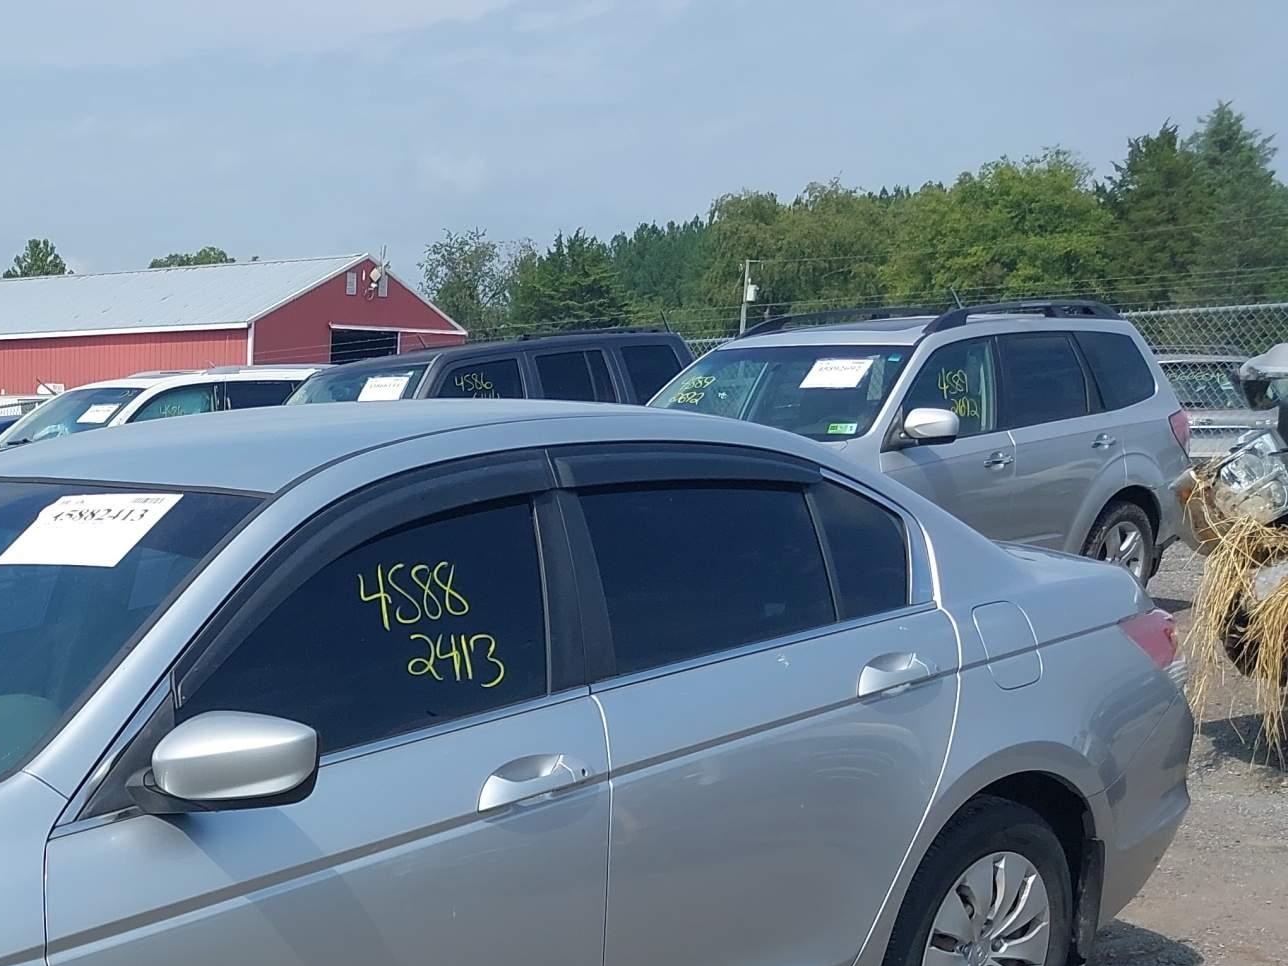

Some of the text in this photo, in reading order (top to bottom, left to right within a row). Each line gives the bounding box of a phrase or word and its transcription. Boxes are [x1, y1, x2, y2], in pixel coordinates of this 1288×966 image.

[455, 372, 493, 391] 4586
[938, 368, 968, 399] 4589
[357, 561, 469, 631] 4588
[407, 633, 505, 688] 2413
